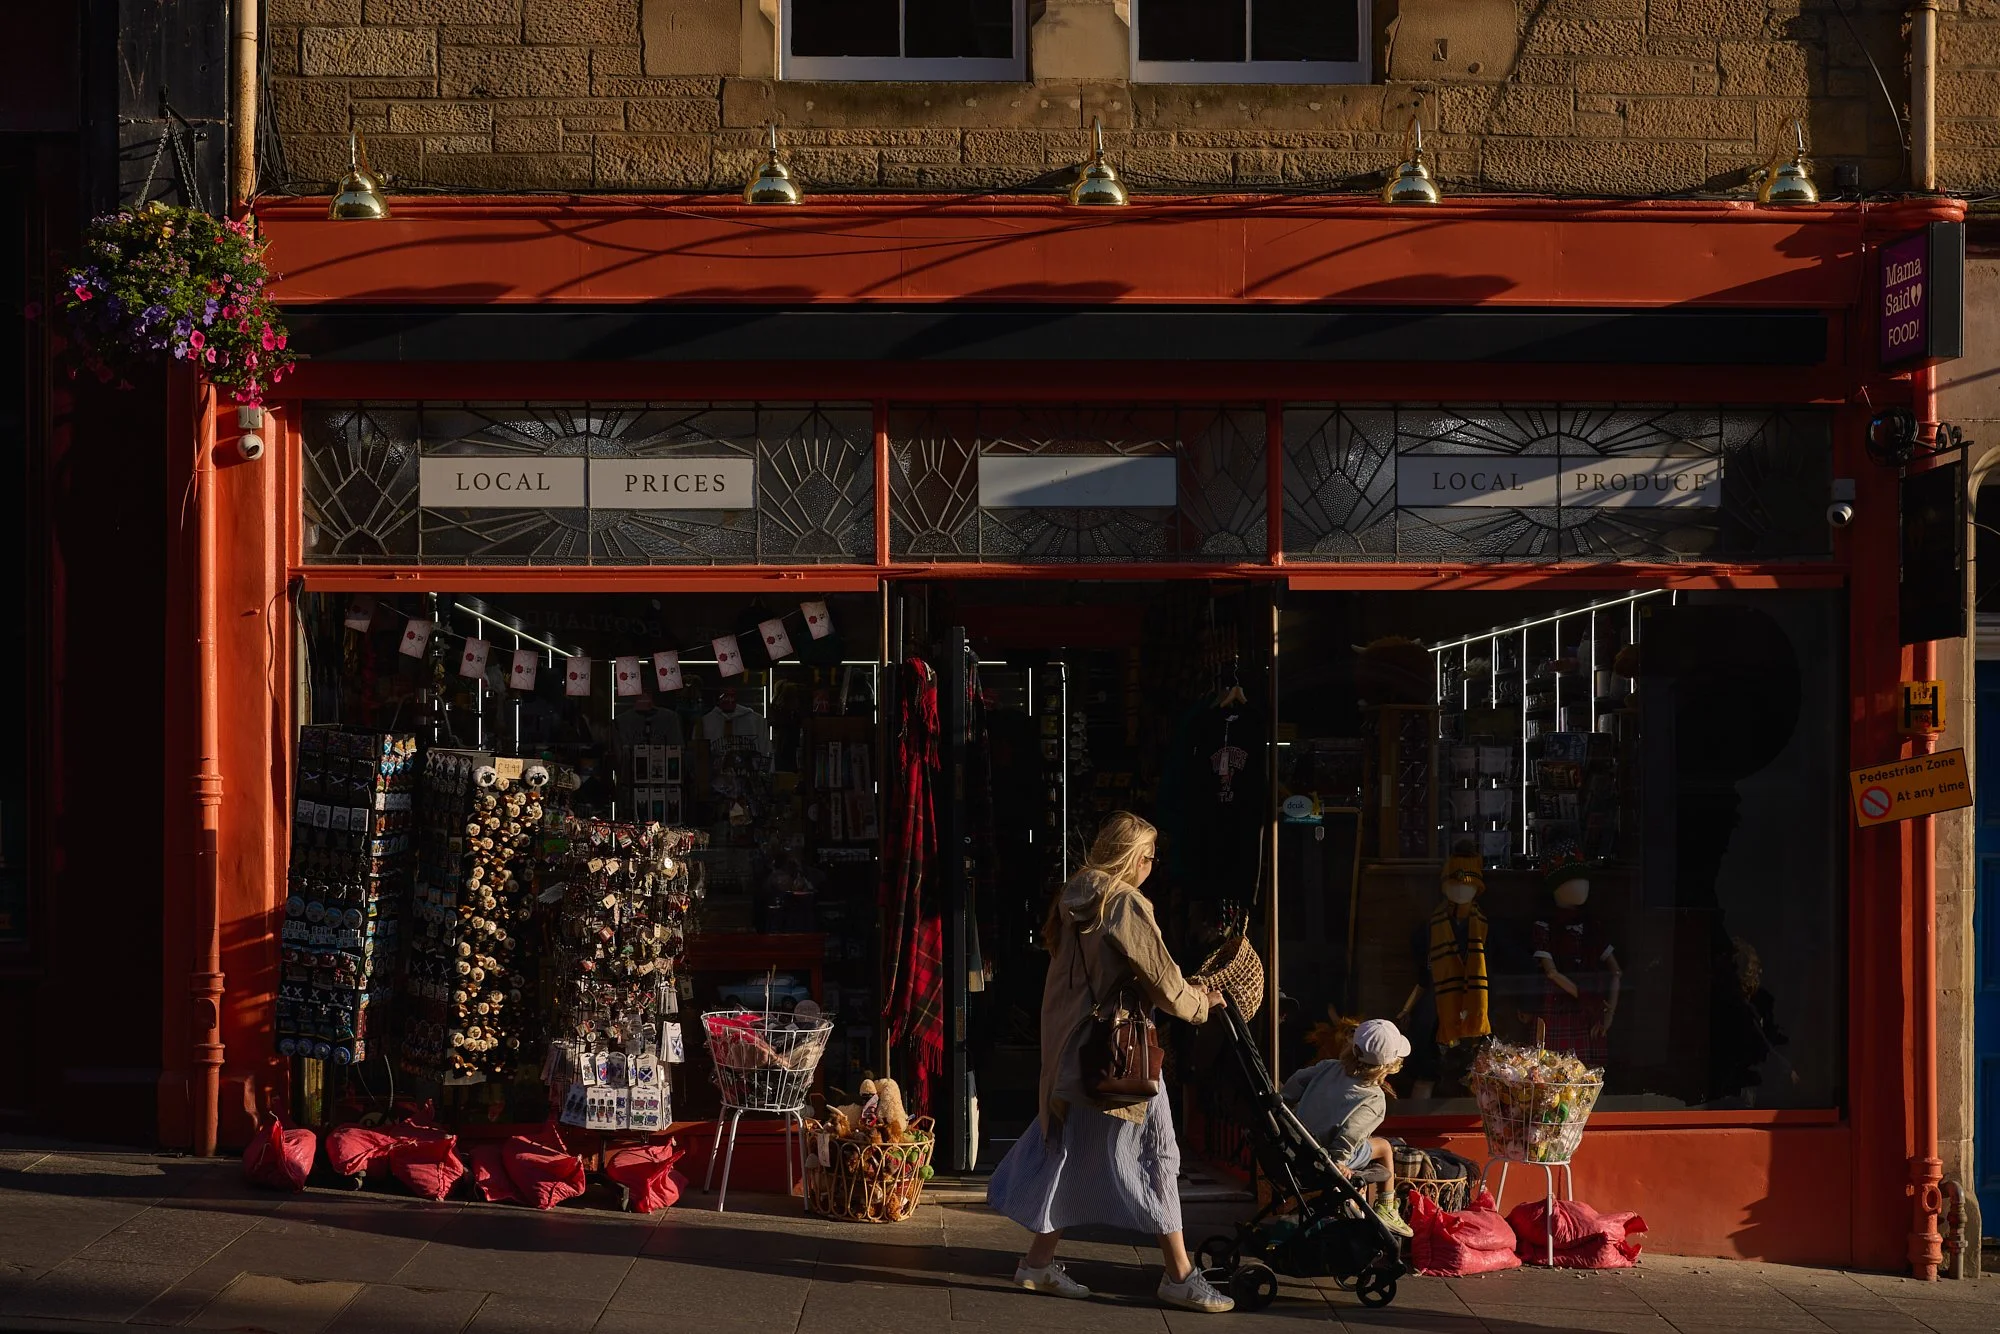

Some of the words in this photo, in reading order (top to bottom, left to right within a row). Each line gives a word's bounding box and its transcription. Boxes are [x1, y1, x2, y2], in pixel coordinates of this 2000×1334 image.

[1885, 257, 1922, 288] Mama
[1885, 286, 1911, 317] Said
[1888, 318, 1920, 348] FOOD!
[456, 472, 551, 492] LOCAL
[625, 474, 726, 493] PRICES
[1432, 472, 1524, 492] LOCAL
[1576, 472, 1707, 493] PRODUCE
[1859, 763, 1923, 784] Pedestrian
[1926, 756, 1956, 771] Zone
[1896, 790, 1912, 803] At
[1914, 786, 1935, 799] any
[1938, 781, 1965, 794] time
